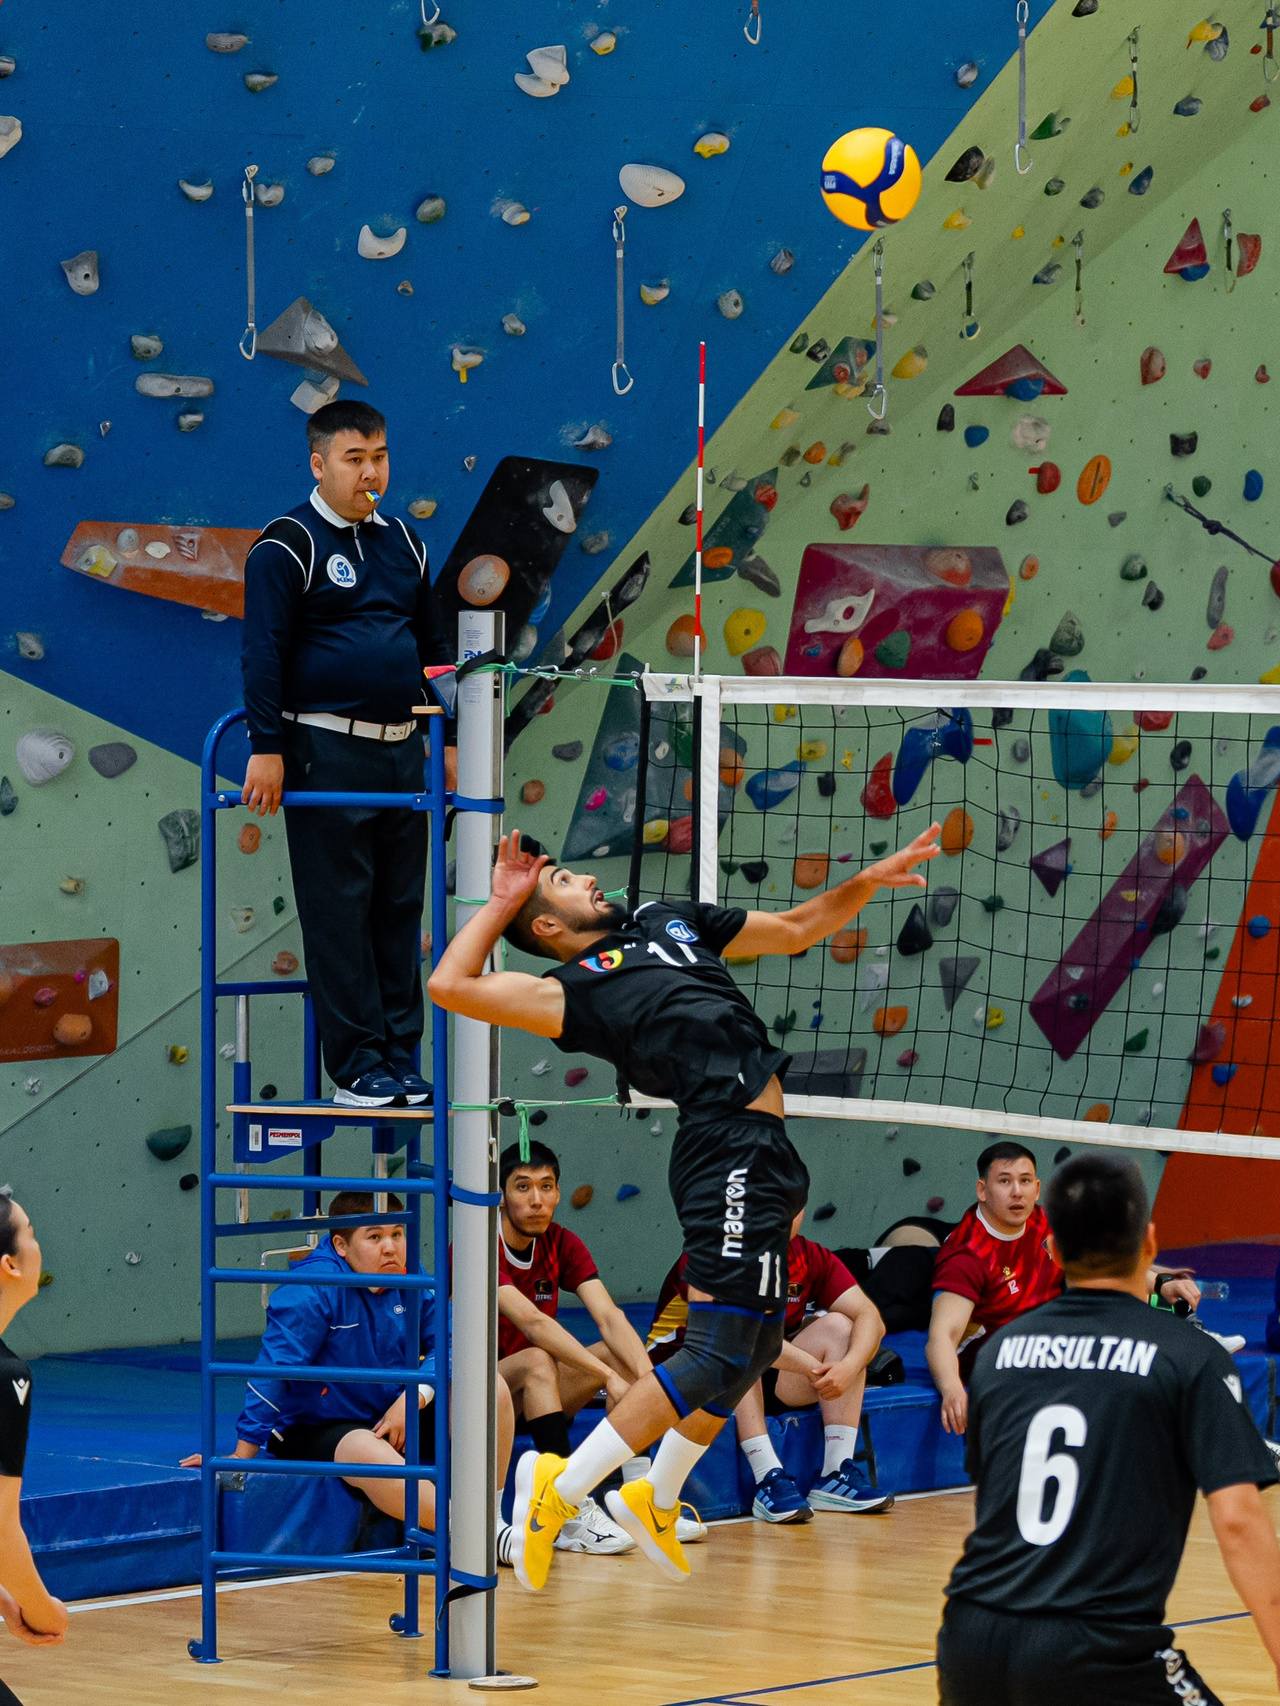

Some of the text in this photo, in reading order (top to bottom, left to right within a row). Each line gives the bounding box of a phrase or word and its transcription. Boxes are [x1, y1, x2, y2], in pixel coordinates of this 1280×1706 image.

[722, 1168, 748, 1257] macron
[758, 1251, 780, 1298] 11
[996, 1335, 1158, 1377] NURSULTAN
[1016, 1404, 1088, 1546] 6
